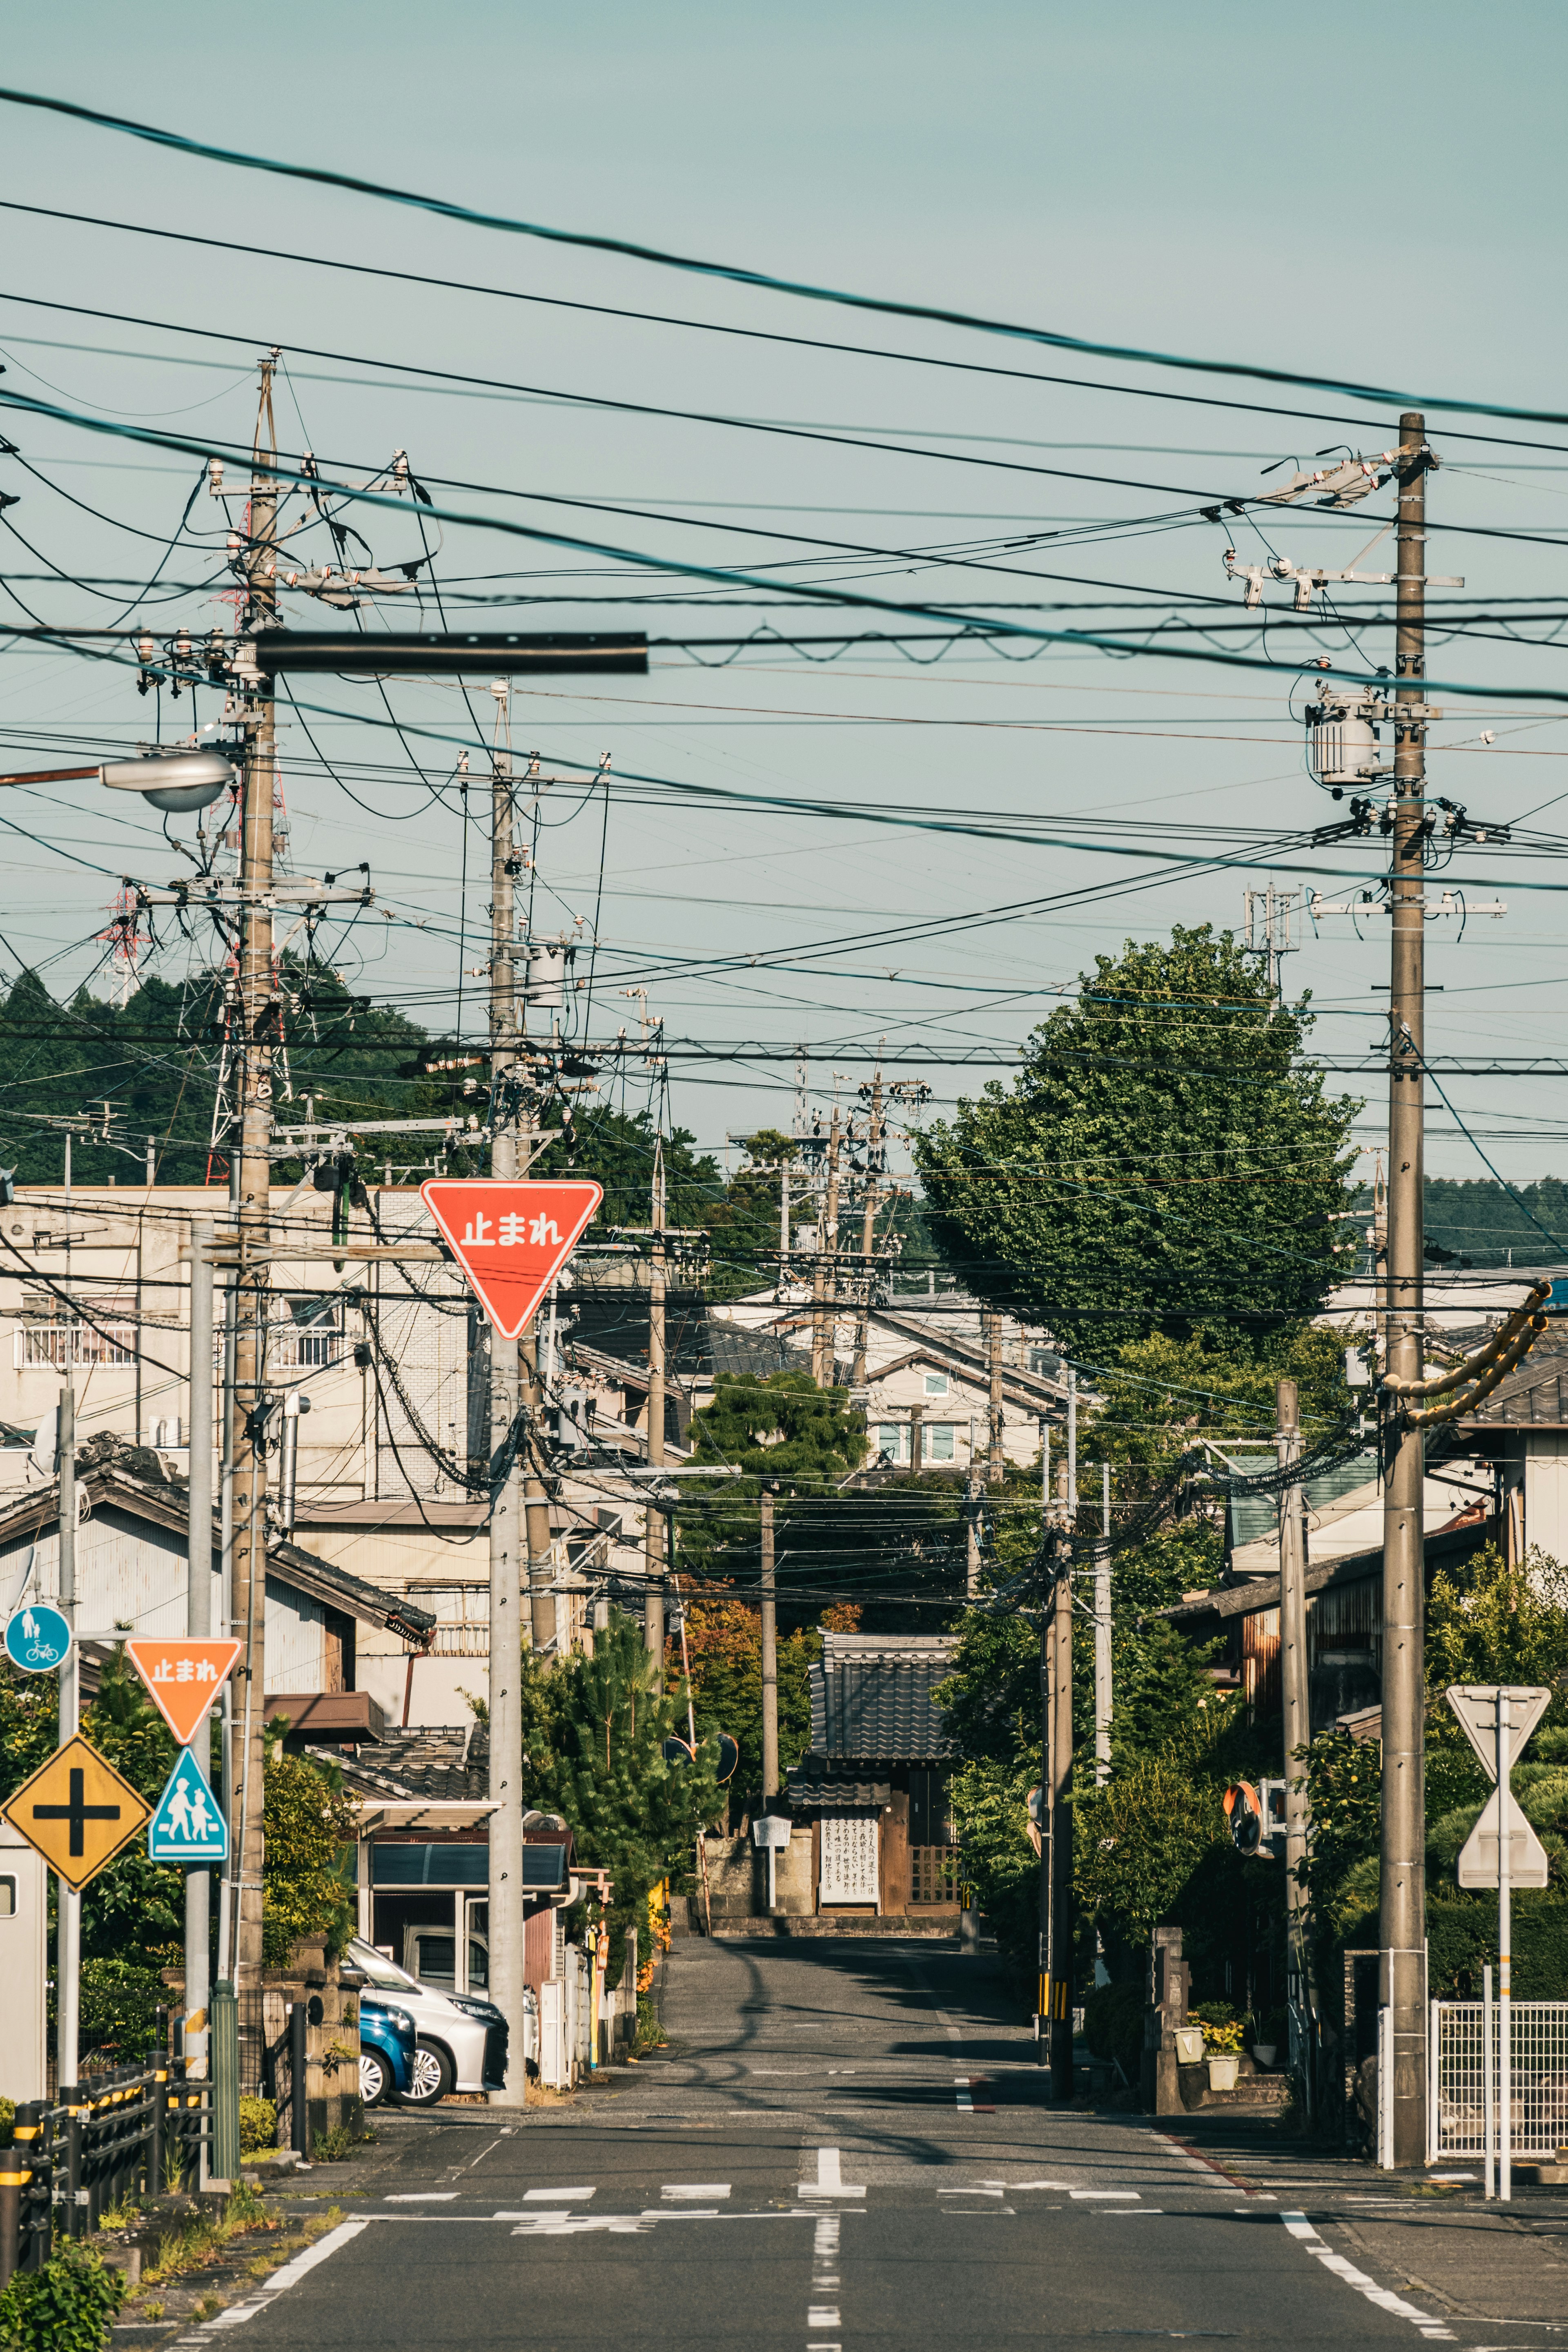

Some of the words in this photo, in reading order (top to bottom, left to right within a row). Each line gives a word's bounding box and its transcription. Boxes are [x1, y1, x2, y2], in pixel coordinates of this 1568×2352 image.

[460, 1212, 564, 1246] 止まれ
[151, 1659, 219, 1682] 止まれ
